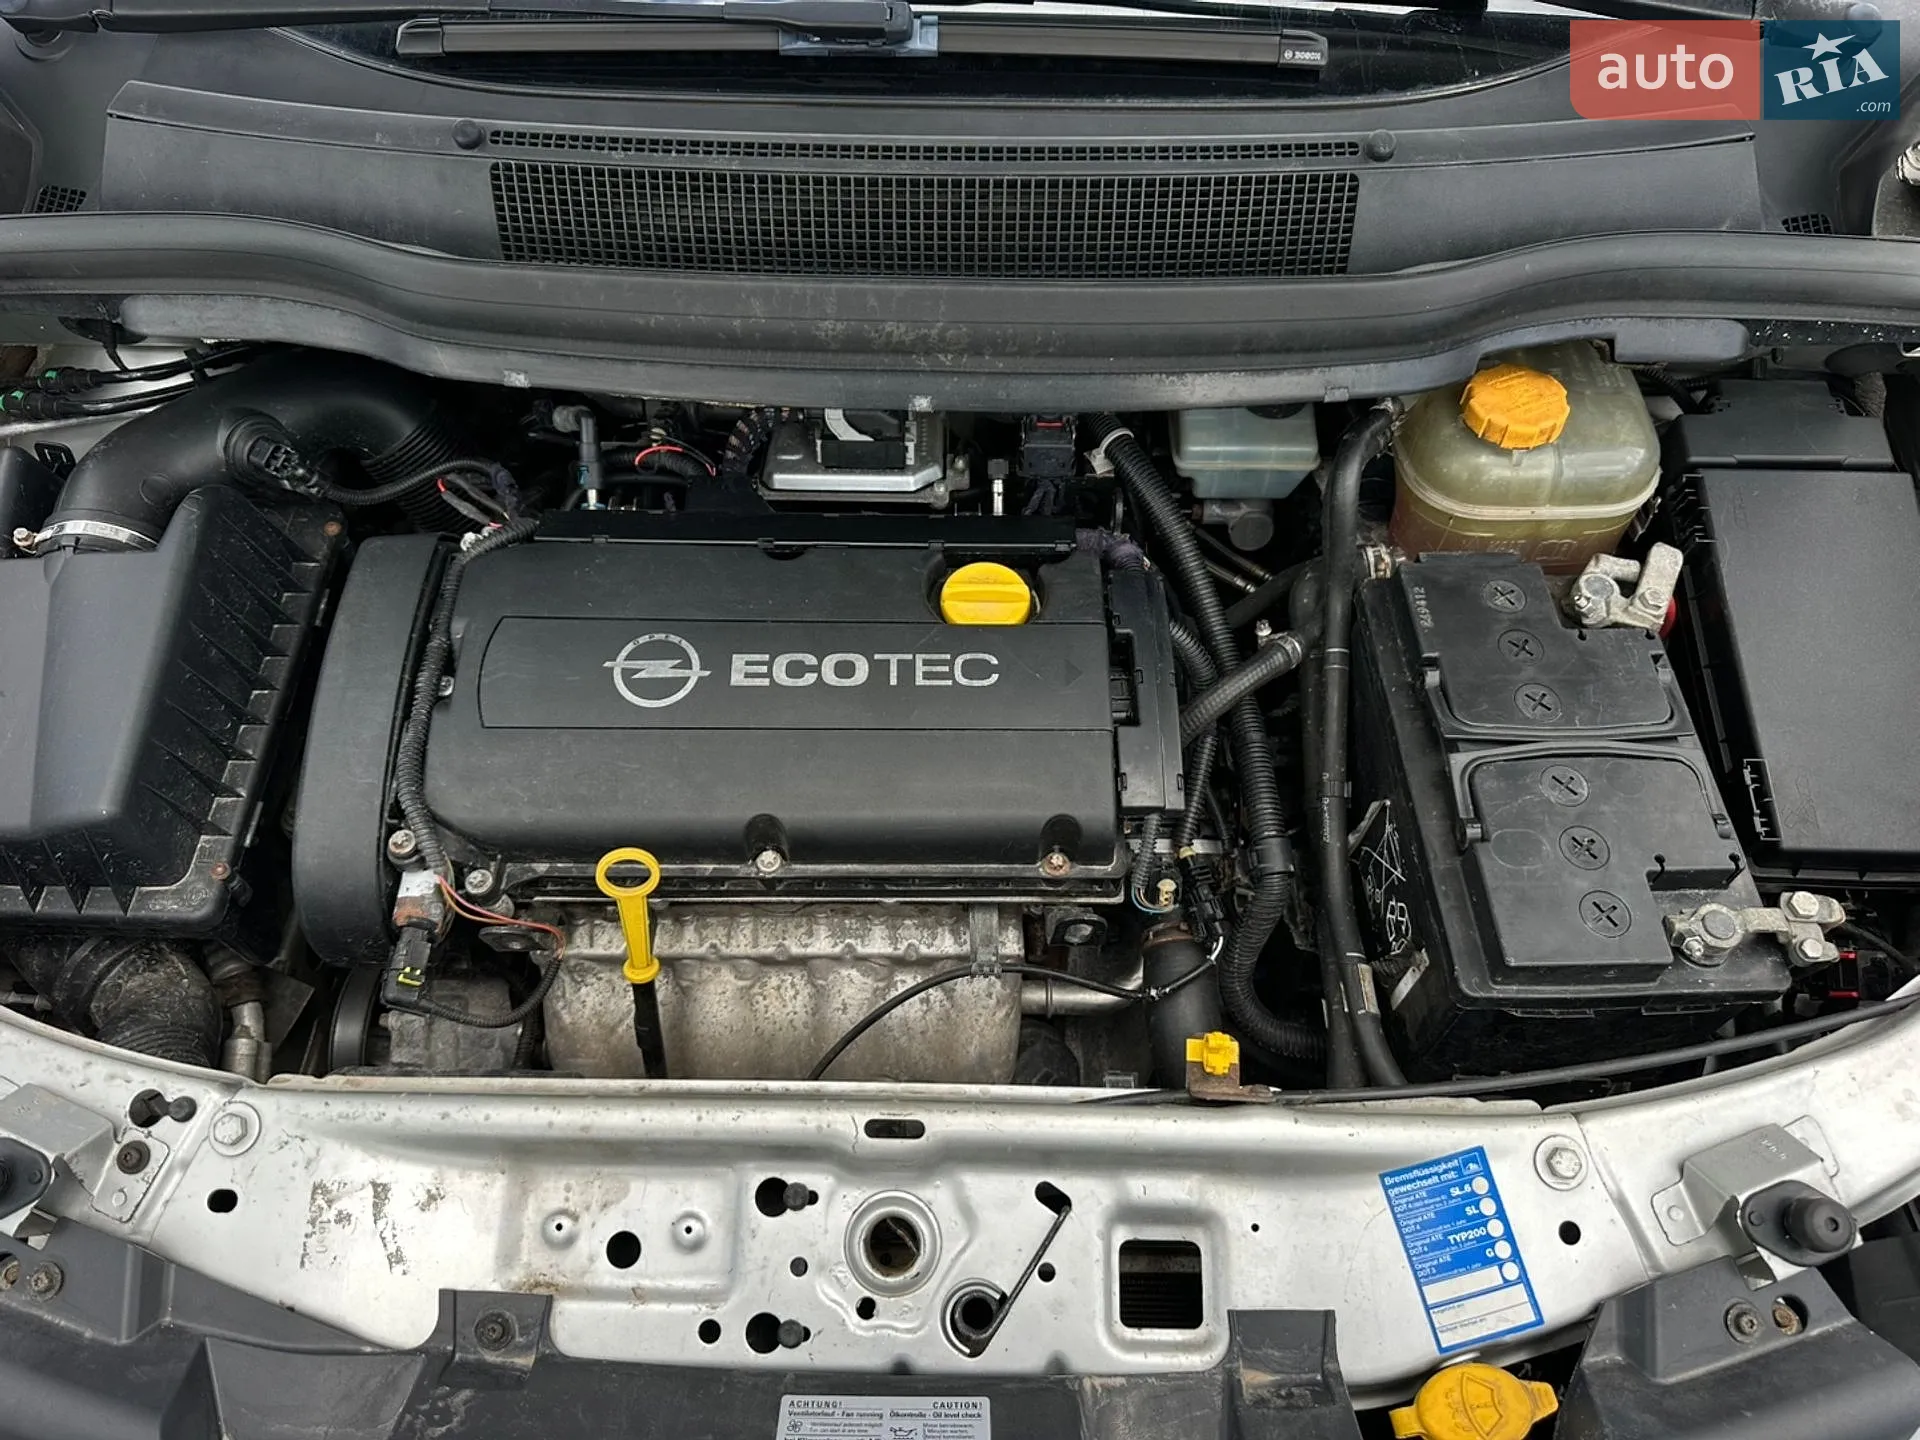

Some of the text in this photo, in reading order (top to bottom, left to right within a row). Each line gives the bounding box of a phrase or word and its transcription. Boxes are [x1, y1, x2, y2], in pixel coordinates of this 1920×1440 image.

[730, 653, 1000, 687] ECOTEC
[1384, 1159, 1459, 1185] Bremsflüssigkeit
[1388, 1170, 1458, 1198] gewechselt mit:
[1465, 1205, 1479, 1216] SL
[1486, 1248, 1495, 1258] G
[789, 1400, 842, 1409] ACHTUNG!
[933, 1401, 983, 1409] CAUTION!
